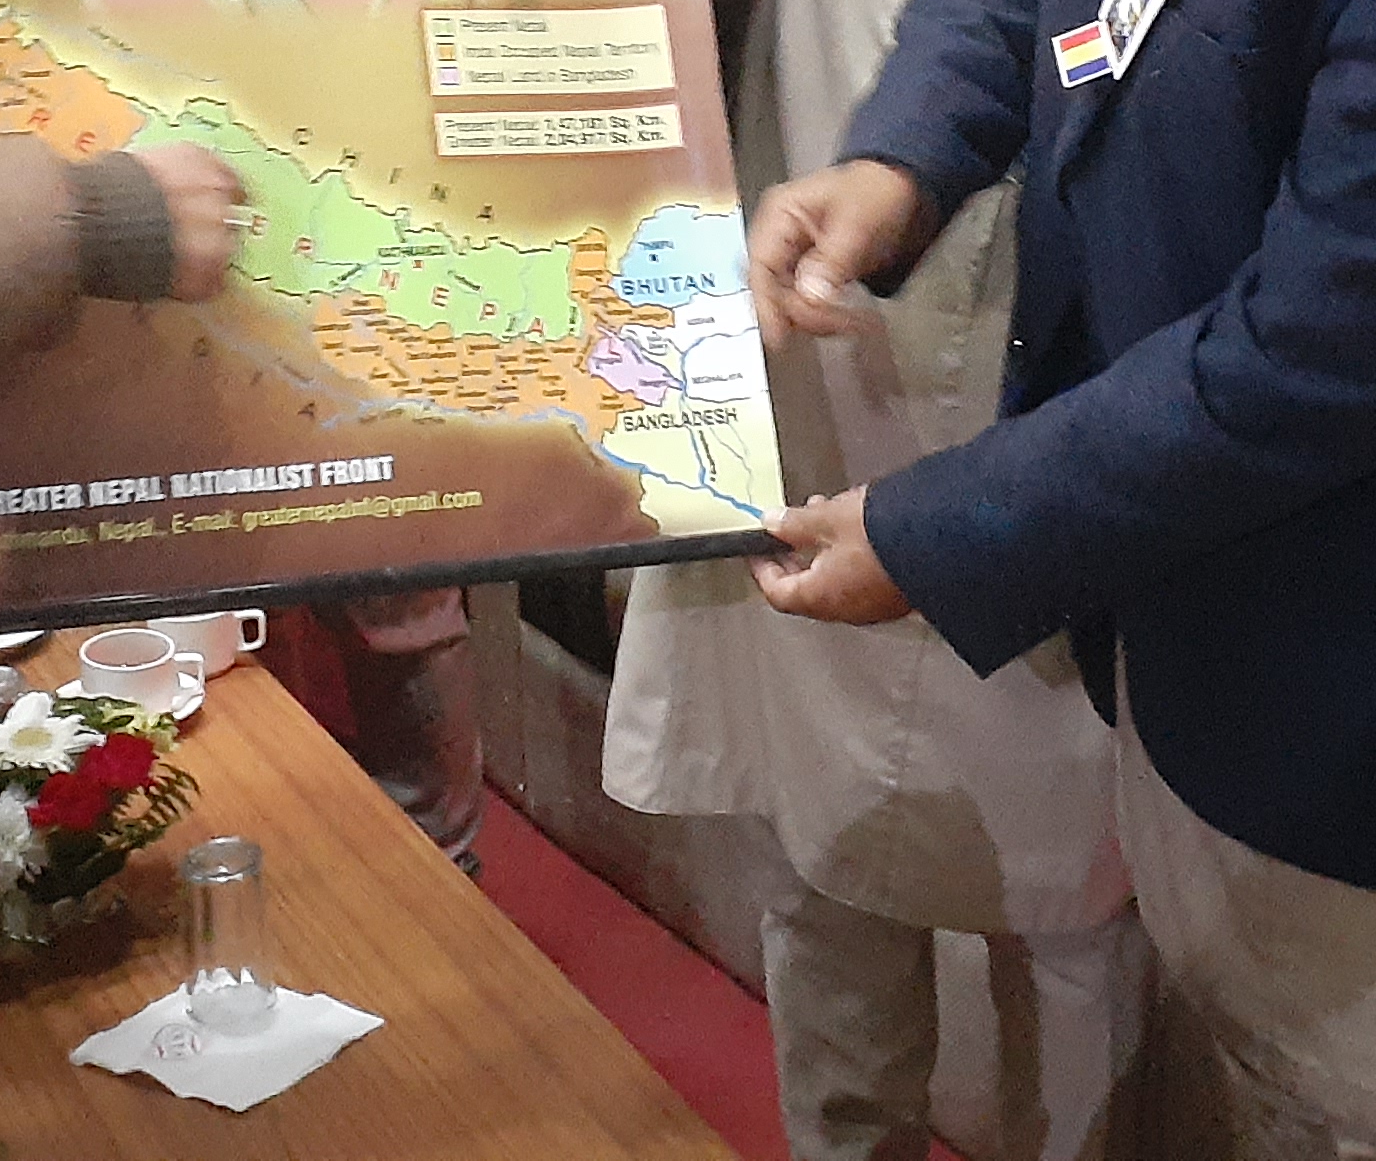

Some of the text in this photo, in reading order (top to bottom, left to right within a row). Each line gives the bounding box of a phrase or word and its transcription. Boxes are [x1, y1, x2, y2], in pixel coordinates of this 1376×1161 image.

[620, 271, 716, 297] BHUTAN
[623, 407, 738, 433] BANGLADESH
[88, 474, 167, 510] NEPAL
[170, 462, 316, 500] NATIONALIST
[318, 453, 396, 488] FRONT
